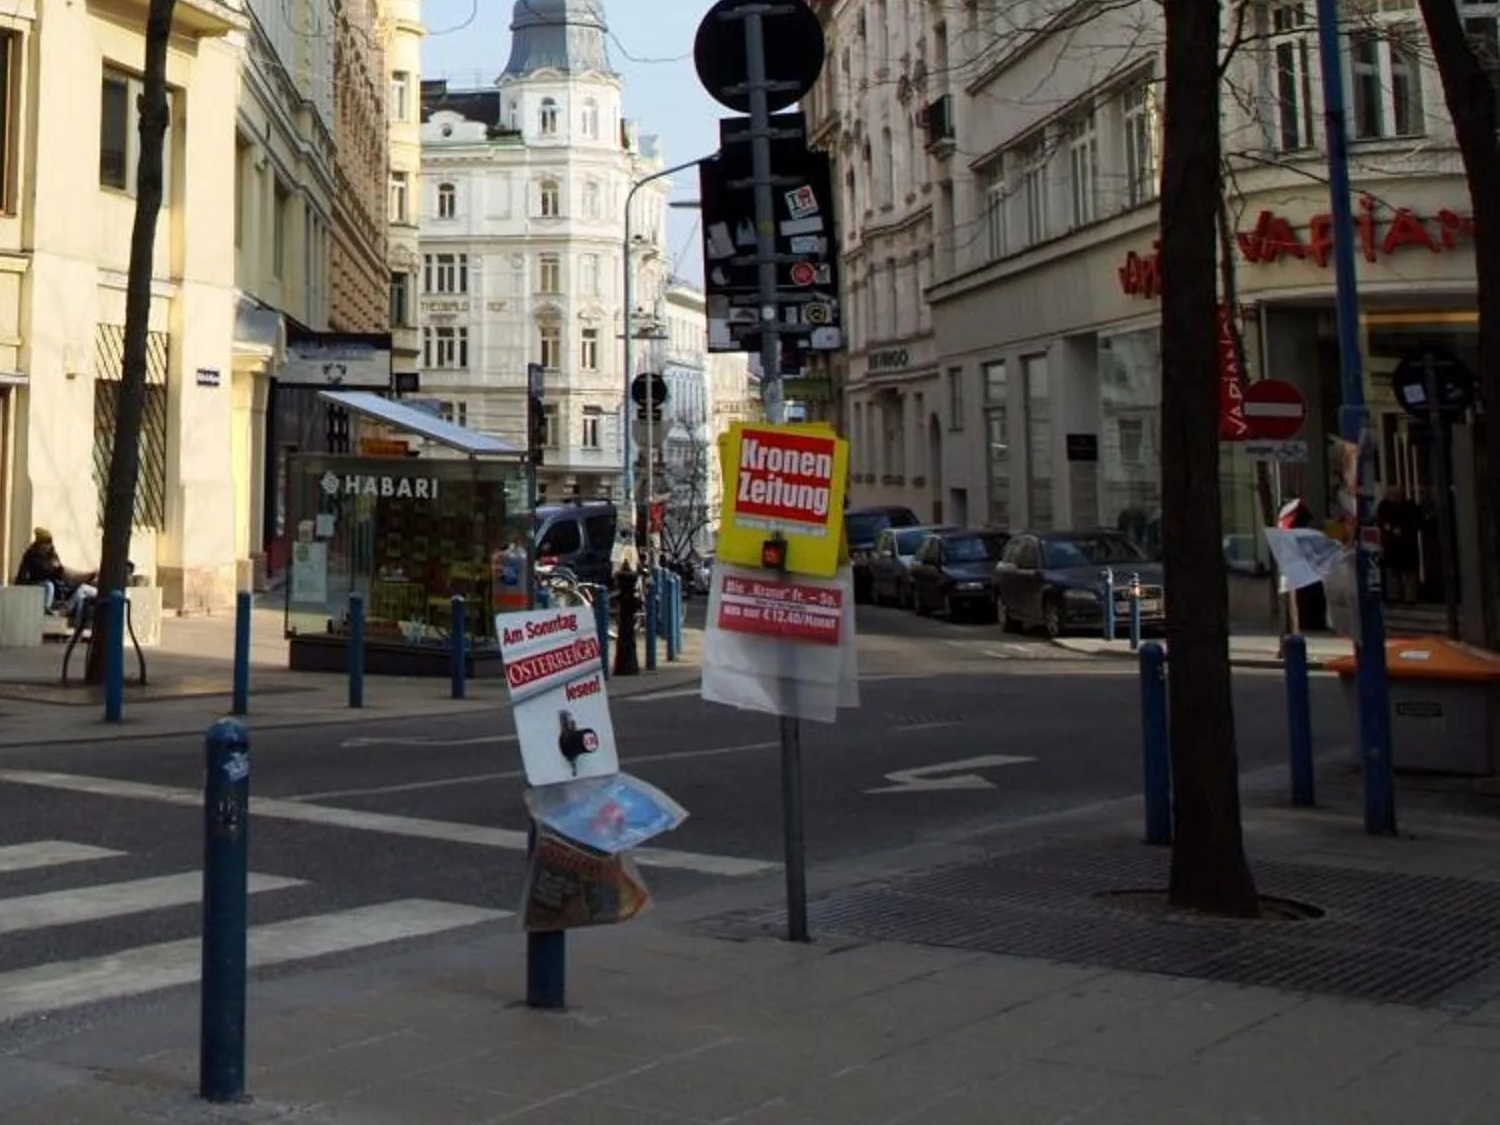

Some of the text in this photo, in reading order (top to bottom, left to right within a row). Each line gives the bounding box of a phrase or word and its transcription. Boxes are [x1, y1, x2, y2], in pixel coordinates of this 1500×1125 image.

[742, 437, 832, 479] Kronen
[345, 475, 438, 499] HABARI
[737, 471, 829, 516] Zeitung
[503, 614, 579, 646] Am Sonntag
[565, 676, 602, 701] lesen!
